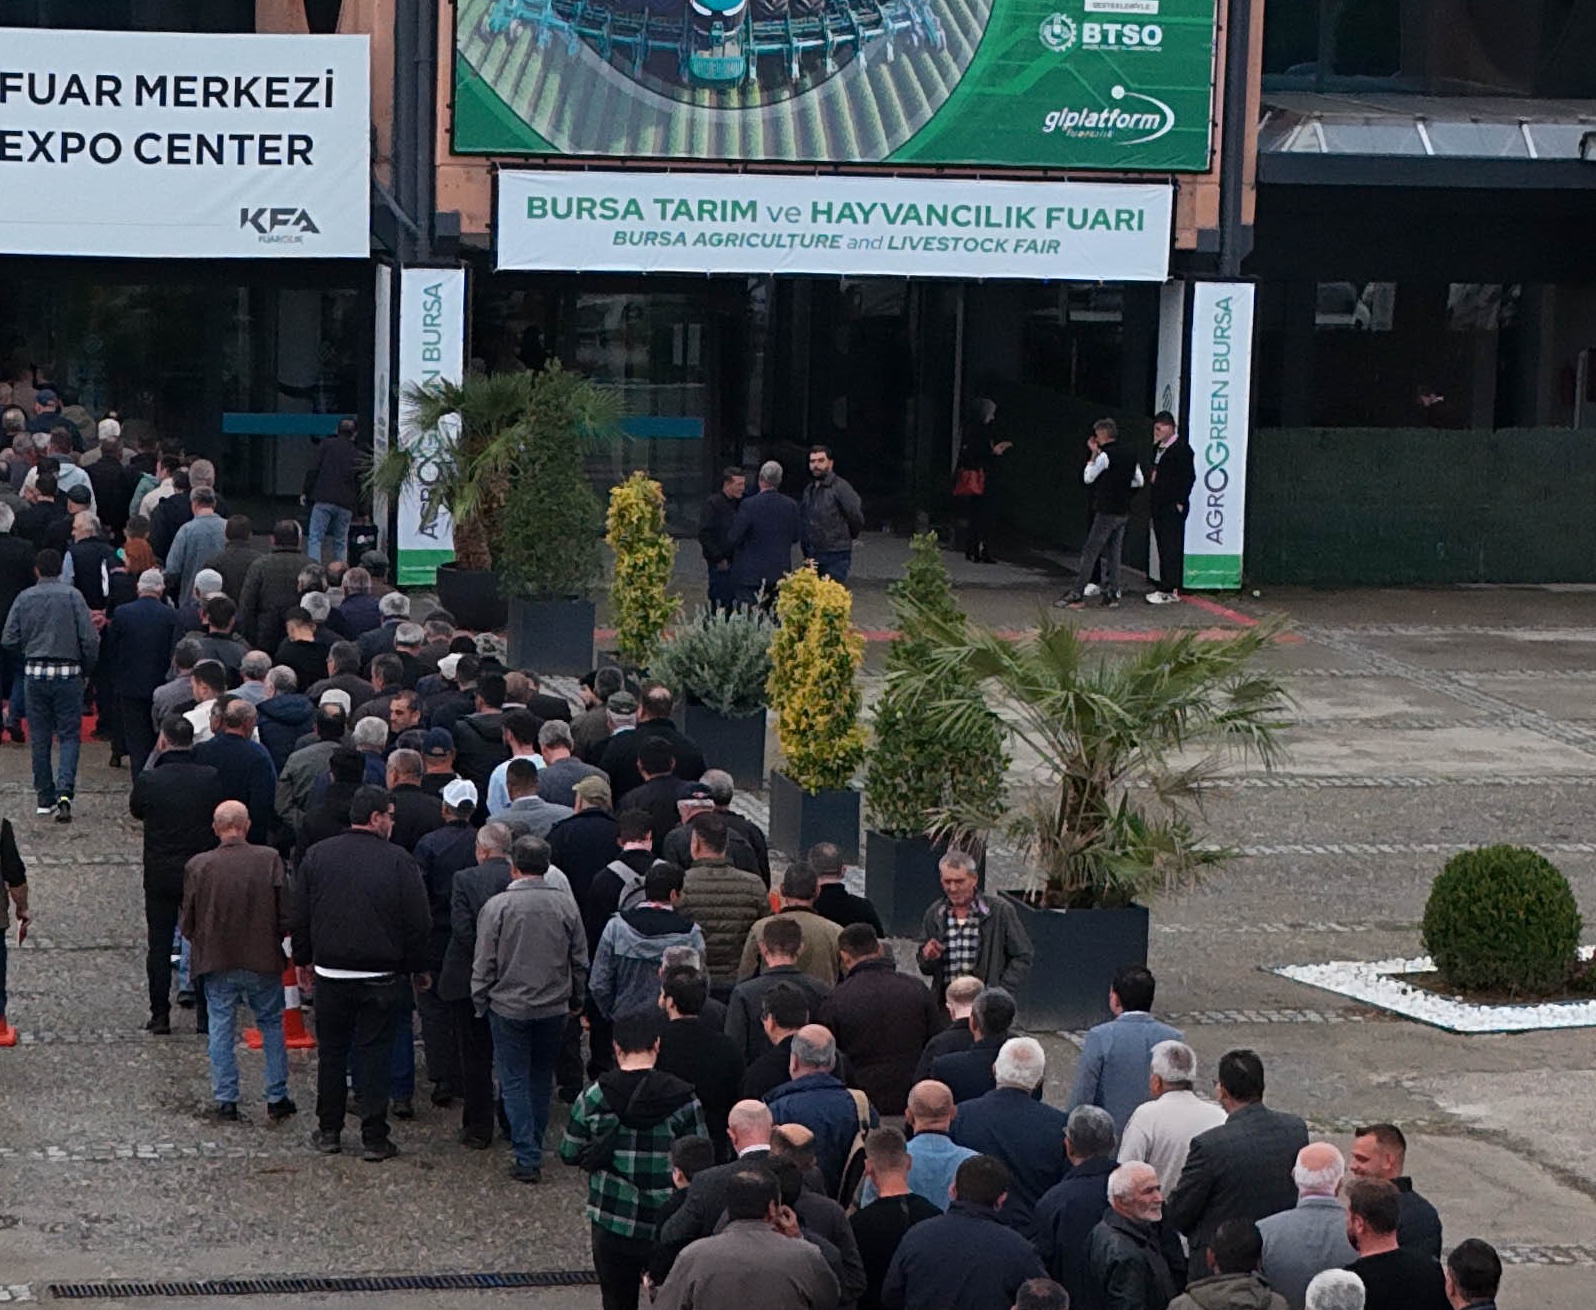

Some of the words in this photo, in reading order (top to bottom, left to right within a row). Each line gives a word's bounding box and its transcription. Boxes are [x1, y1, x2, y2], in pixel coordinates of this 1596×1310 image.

[1082, 23, 1162, 45] BTSO
[136, 69, 334, 108] MERKEZİ
[0, 132, 121, 164] EXPO
[134, 133, 314, 166] CENTER
[239, 206, 321, 235] KFA
[526, 195, 644, 223] BURSA
[653, 197, 758, 224] TARIM
[767, 206, 801, 225] ve
[810, 202, 1037, 230] HAYVANCILIK
[1047, 207, 1145, 232] FUARI
[612, 230, 688, 247] BURSA
[693, 232, 842, 250] AGRICULTURE
[846, 233, 883, 251] and
[887, 235, 1009, 254] LIVESTOCK
[1013, 238, 1061, 254] FAIR
[422, 282, 442, 362] BURSA
[1212, 296, 1233, 372] BURSA
[1205, 380, 1229, 545] AGROGREEN
